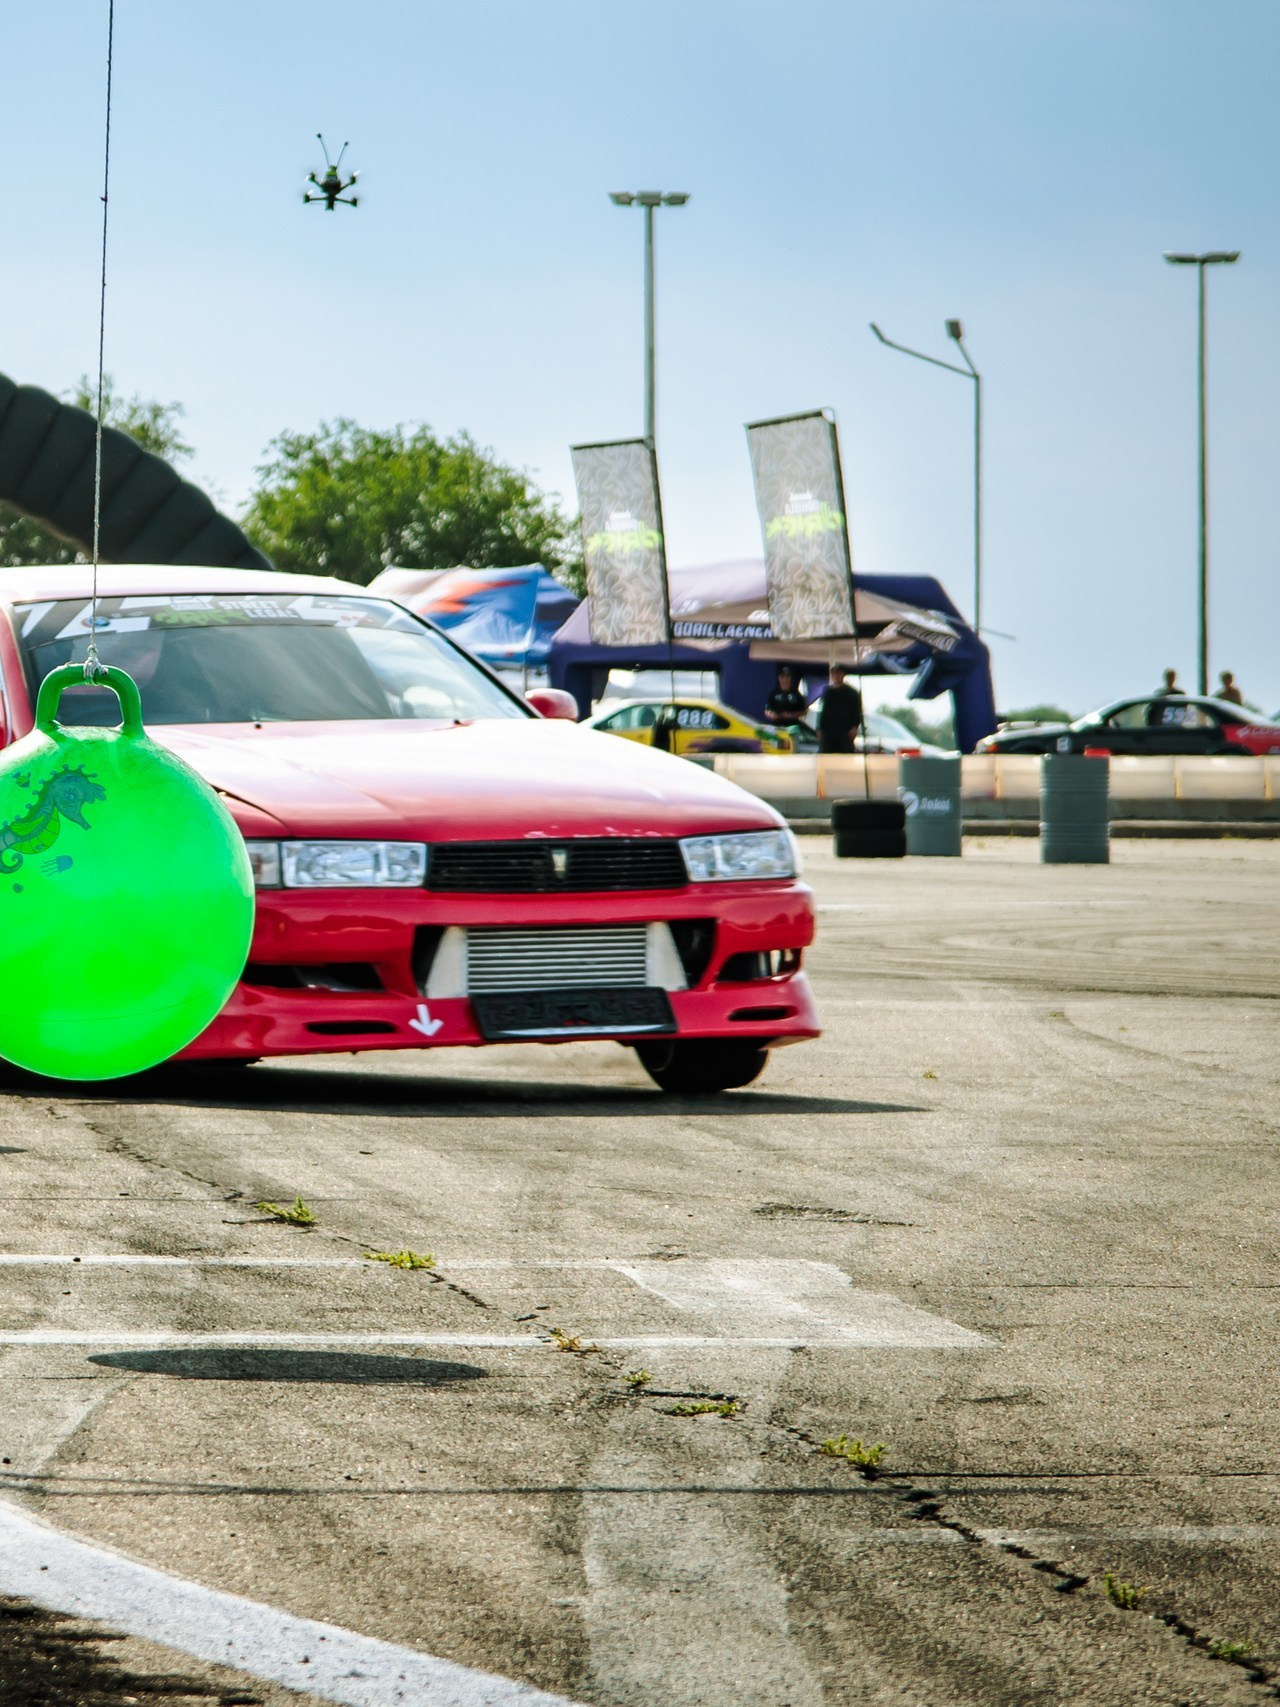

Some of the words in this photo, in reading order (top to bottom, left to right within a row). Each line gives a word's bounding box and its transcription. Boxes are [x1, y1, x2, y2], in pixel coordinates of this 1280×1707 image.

[218, 600, 281, 610] STREET
[245, 608, 299, 618] LEGAL
[673, 621, 775, 638] GORILLAENER
